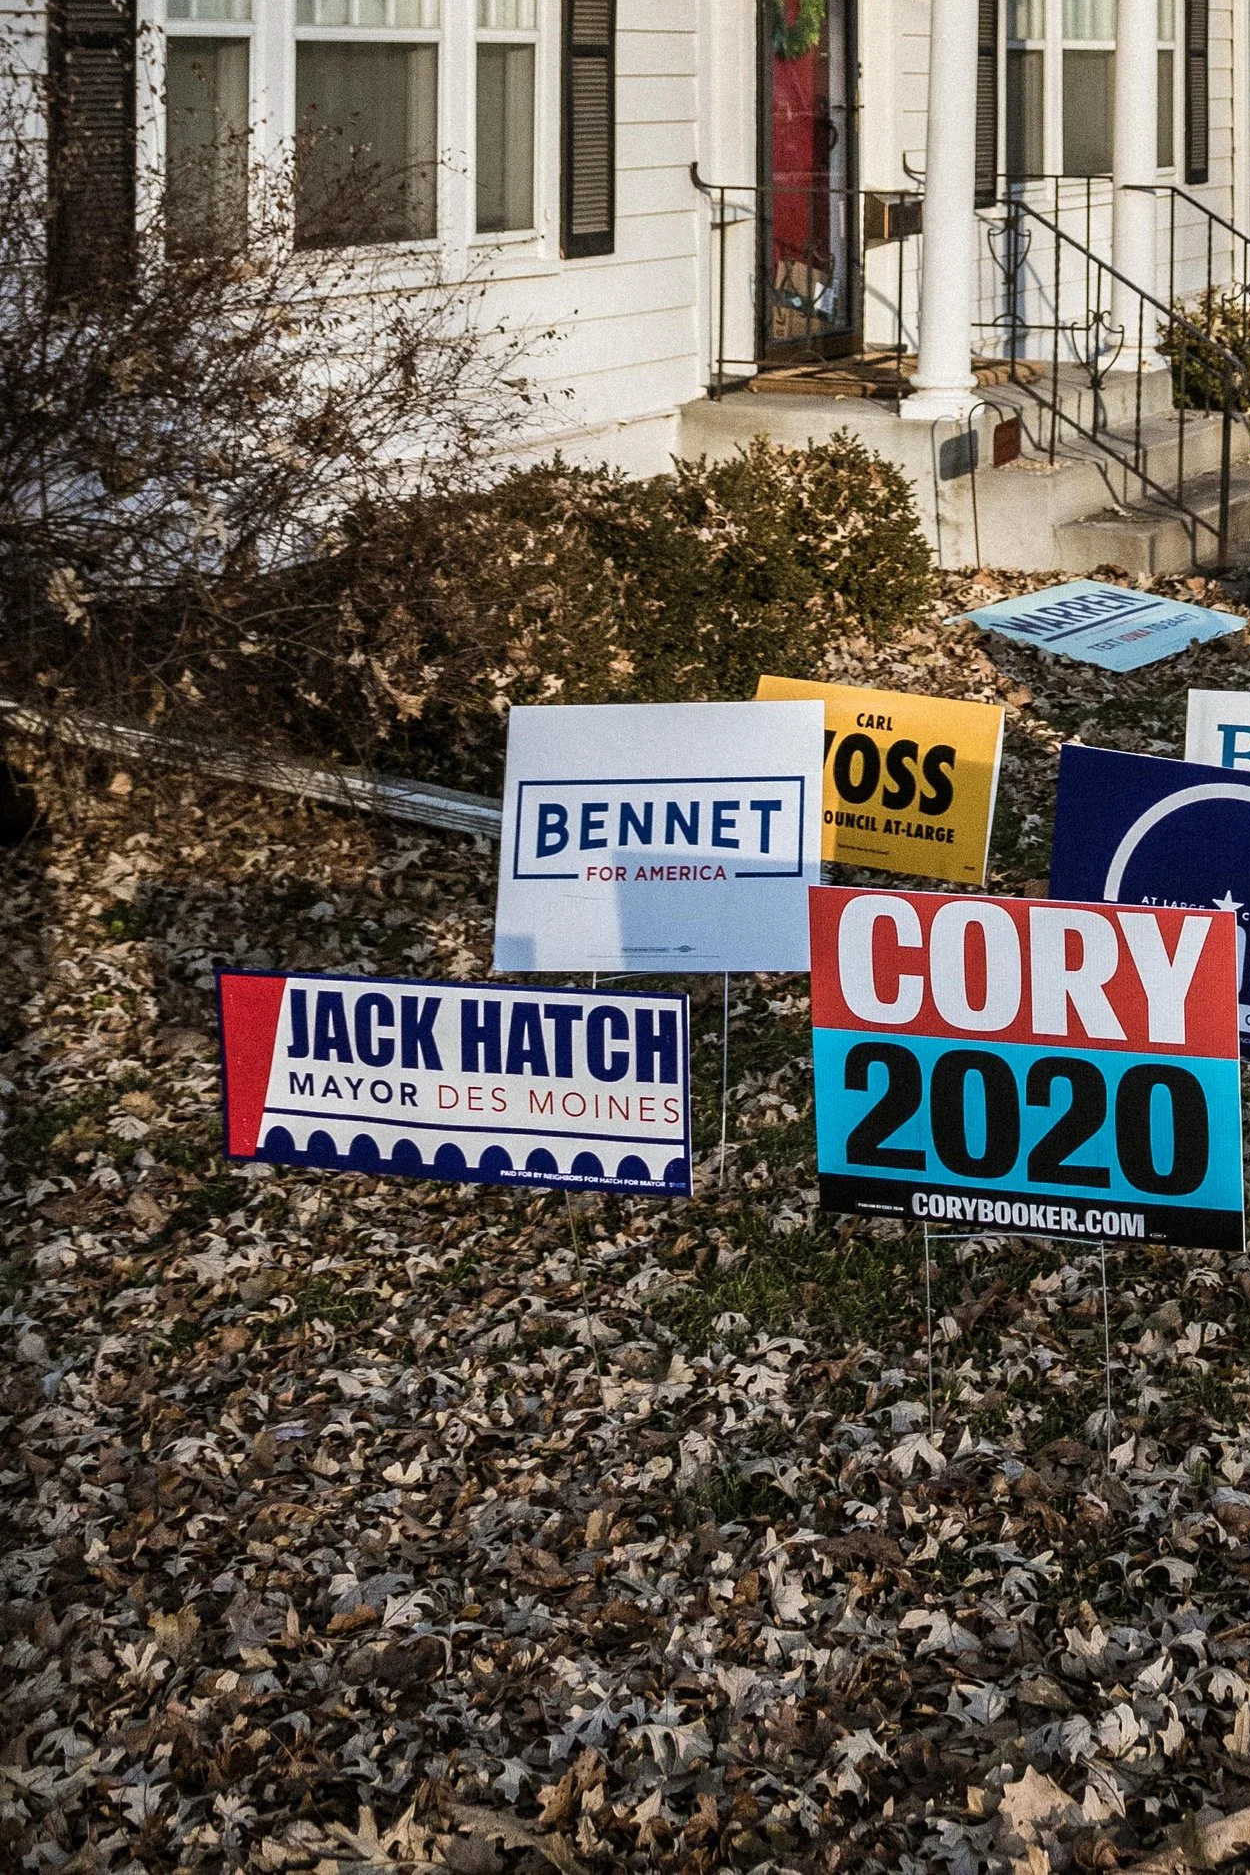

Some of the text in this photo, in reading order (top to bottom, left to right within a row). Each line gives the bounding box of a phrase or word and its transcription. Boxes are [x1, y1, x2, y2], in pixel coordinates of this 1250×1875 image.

[988, 589, 1146, 636] WARREN
[856, 712, 893, 731] CARL
[536, 799, 782, 859] BENNET
[824, 810, 955, 844] OUNCIL AT-LARGE
[586, 865, 727, 882] FOR AMERICA
[1141, 895, 1158, 905] AT
[837, 894, 1214, 1045] CORY
[287, 989, 679, 1084] JACK HATCH
[289, 1071, 680, 1123] MAYOR DES MOINES
[843, 1041, 1210, 1195] 2020
[912, 1192, 1145, 1238] CORYBOOKER.COM
